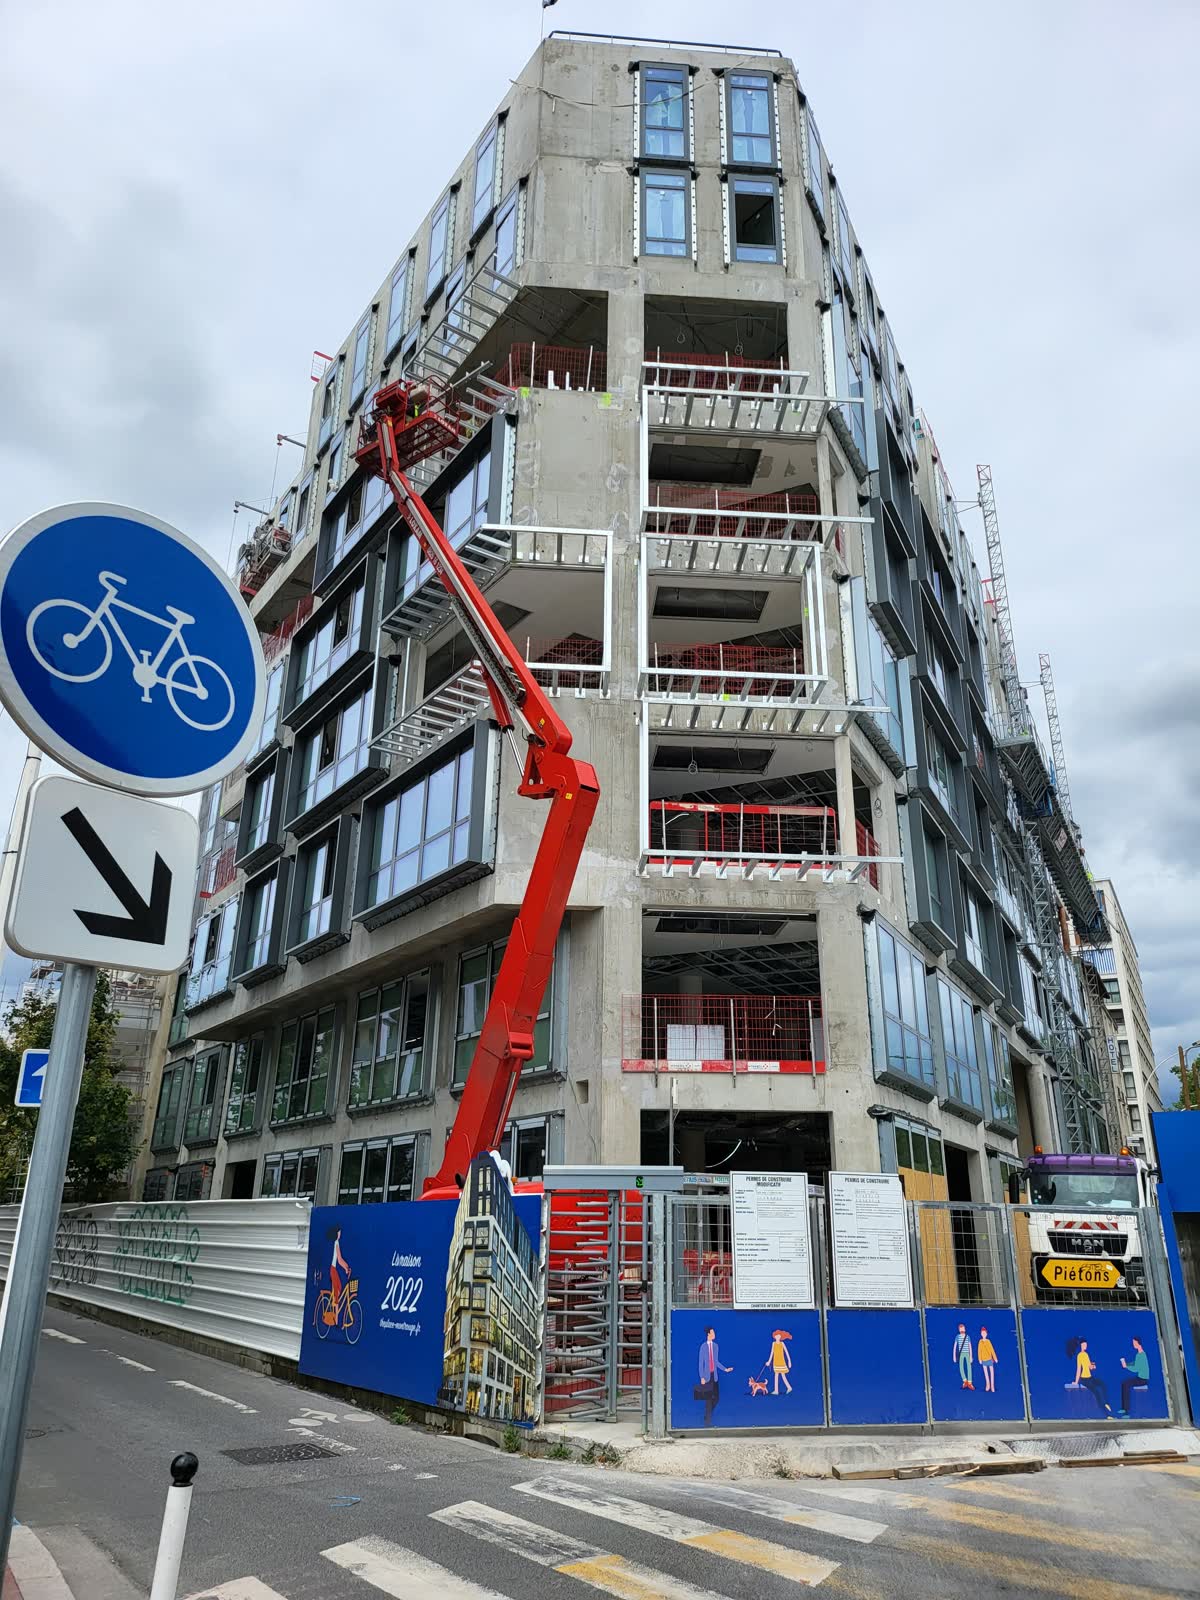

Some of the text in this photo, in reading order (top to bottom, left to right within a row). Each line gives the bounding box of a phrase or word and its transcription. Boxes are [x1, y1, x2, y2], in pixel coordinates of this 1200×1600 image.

[1107, 1037, 1118, 1073] HOTEL
[1071, 1238, 1105, 1247] MAN
[391, 1250, 422, 1267] Livraison
[1054, 1265, 1110, 1281] Piétons
[380, 1276, 424, 1313] 2022
